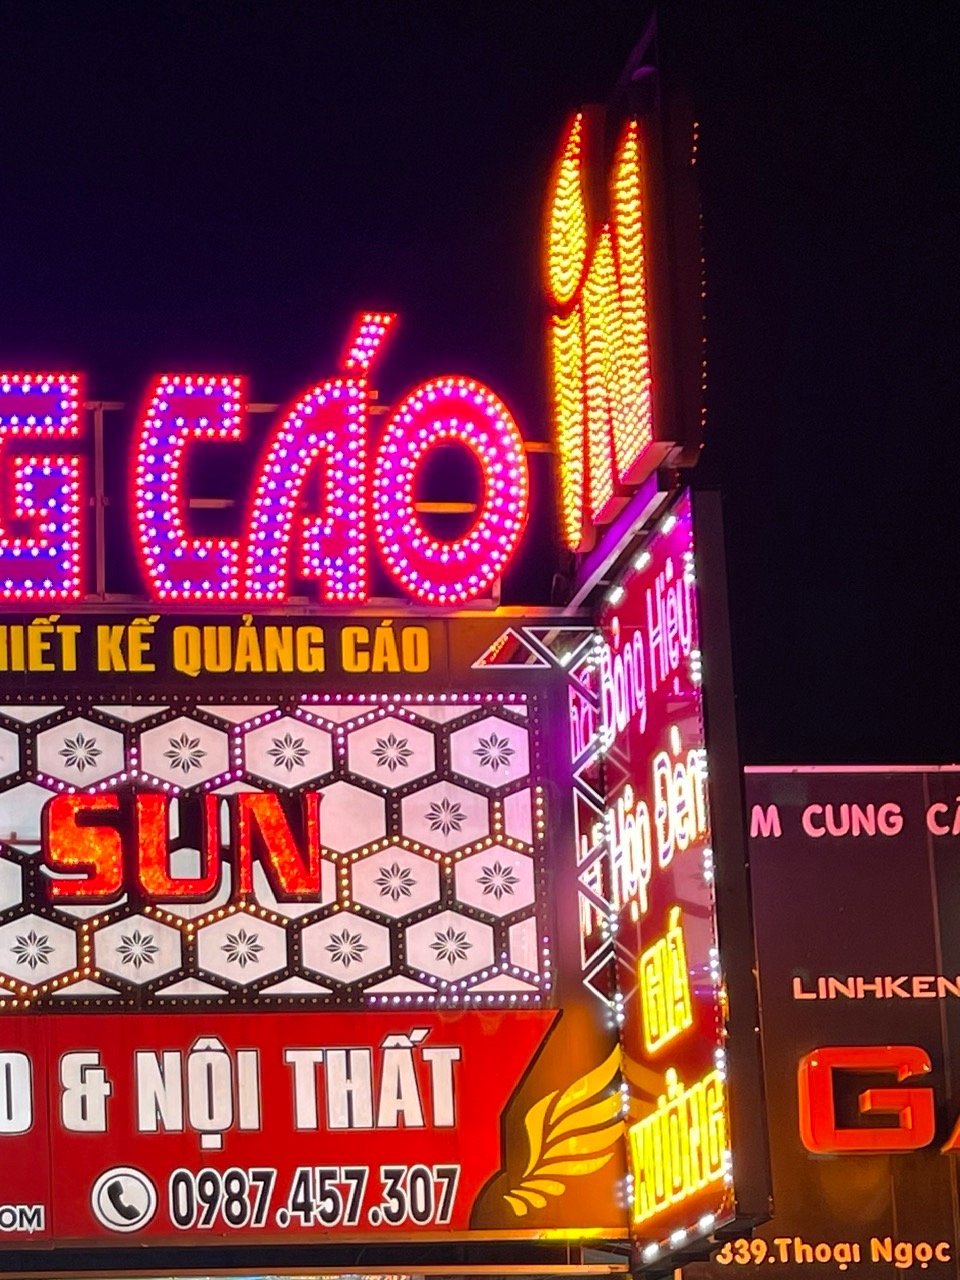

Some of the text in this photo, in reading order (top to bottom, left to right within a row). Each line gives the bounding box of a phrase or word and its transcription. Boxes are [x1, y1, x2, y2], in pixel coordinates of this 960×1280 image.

[133, 312, 528, 602] CÁO
[97, 614, 161, 672] KẾ
[173, 613, 326, 677] QUẢNG
[341, 619, 431, 673] CÁO
[42, 792, 322, 904] SUN
[802, 802, 904, 838] CUNG
[59, 1049, 113, 1133] &
[135, 1034, 262, 1150] NỘI
[283, 1026, 462, 1130] THẤT
[167, 1163, 461, 1230] 0987.457.307
[871, 1237, 952, 1270] Ngọc
